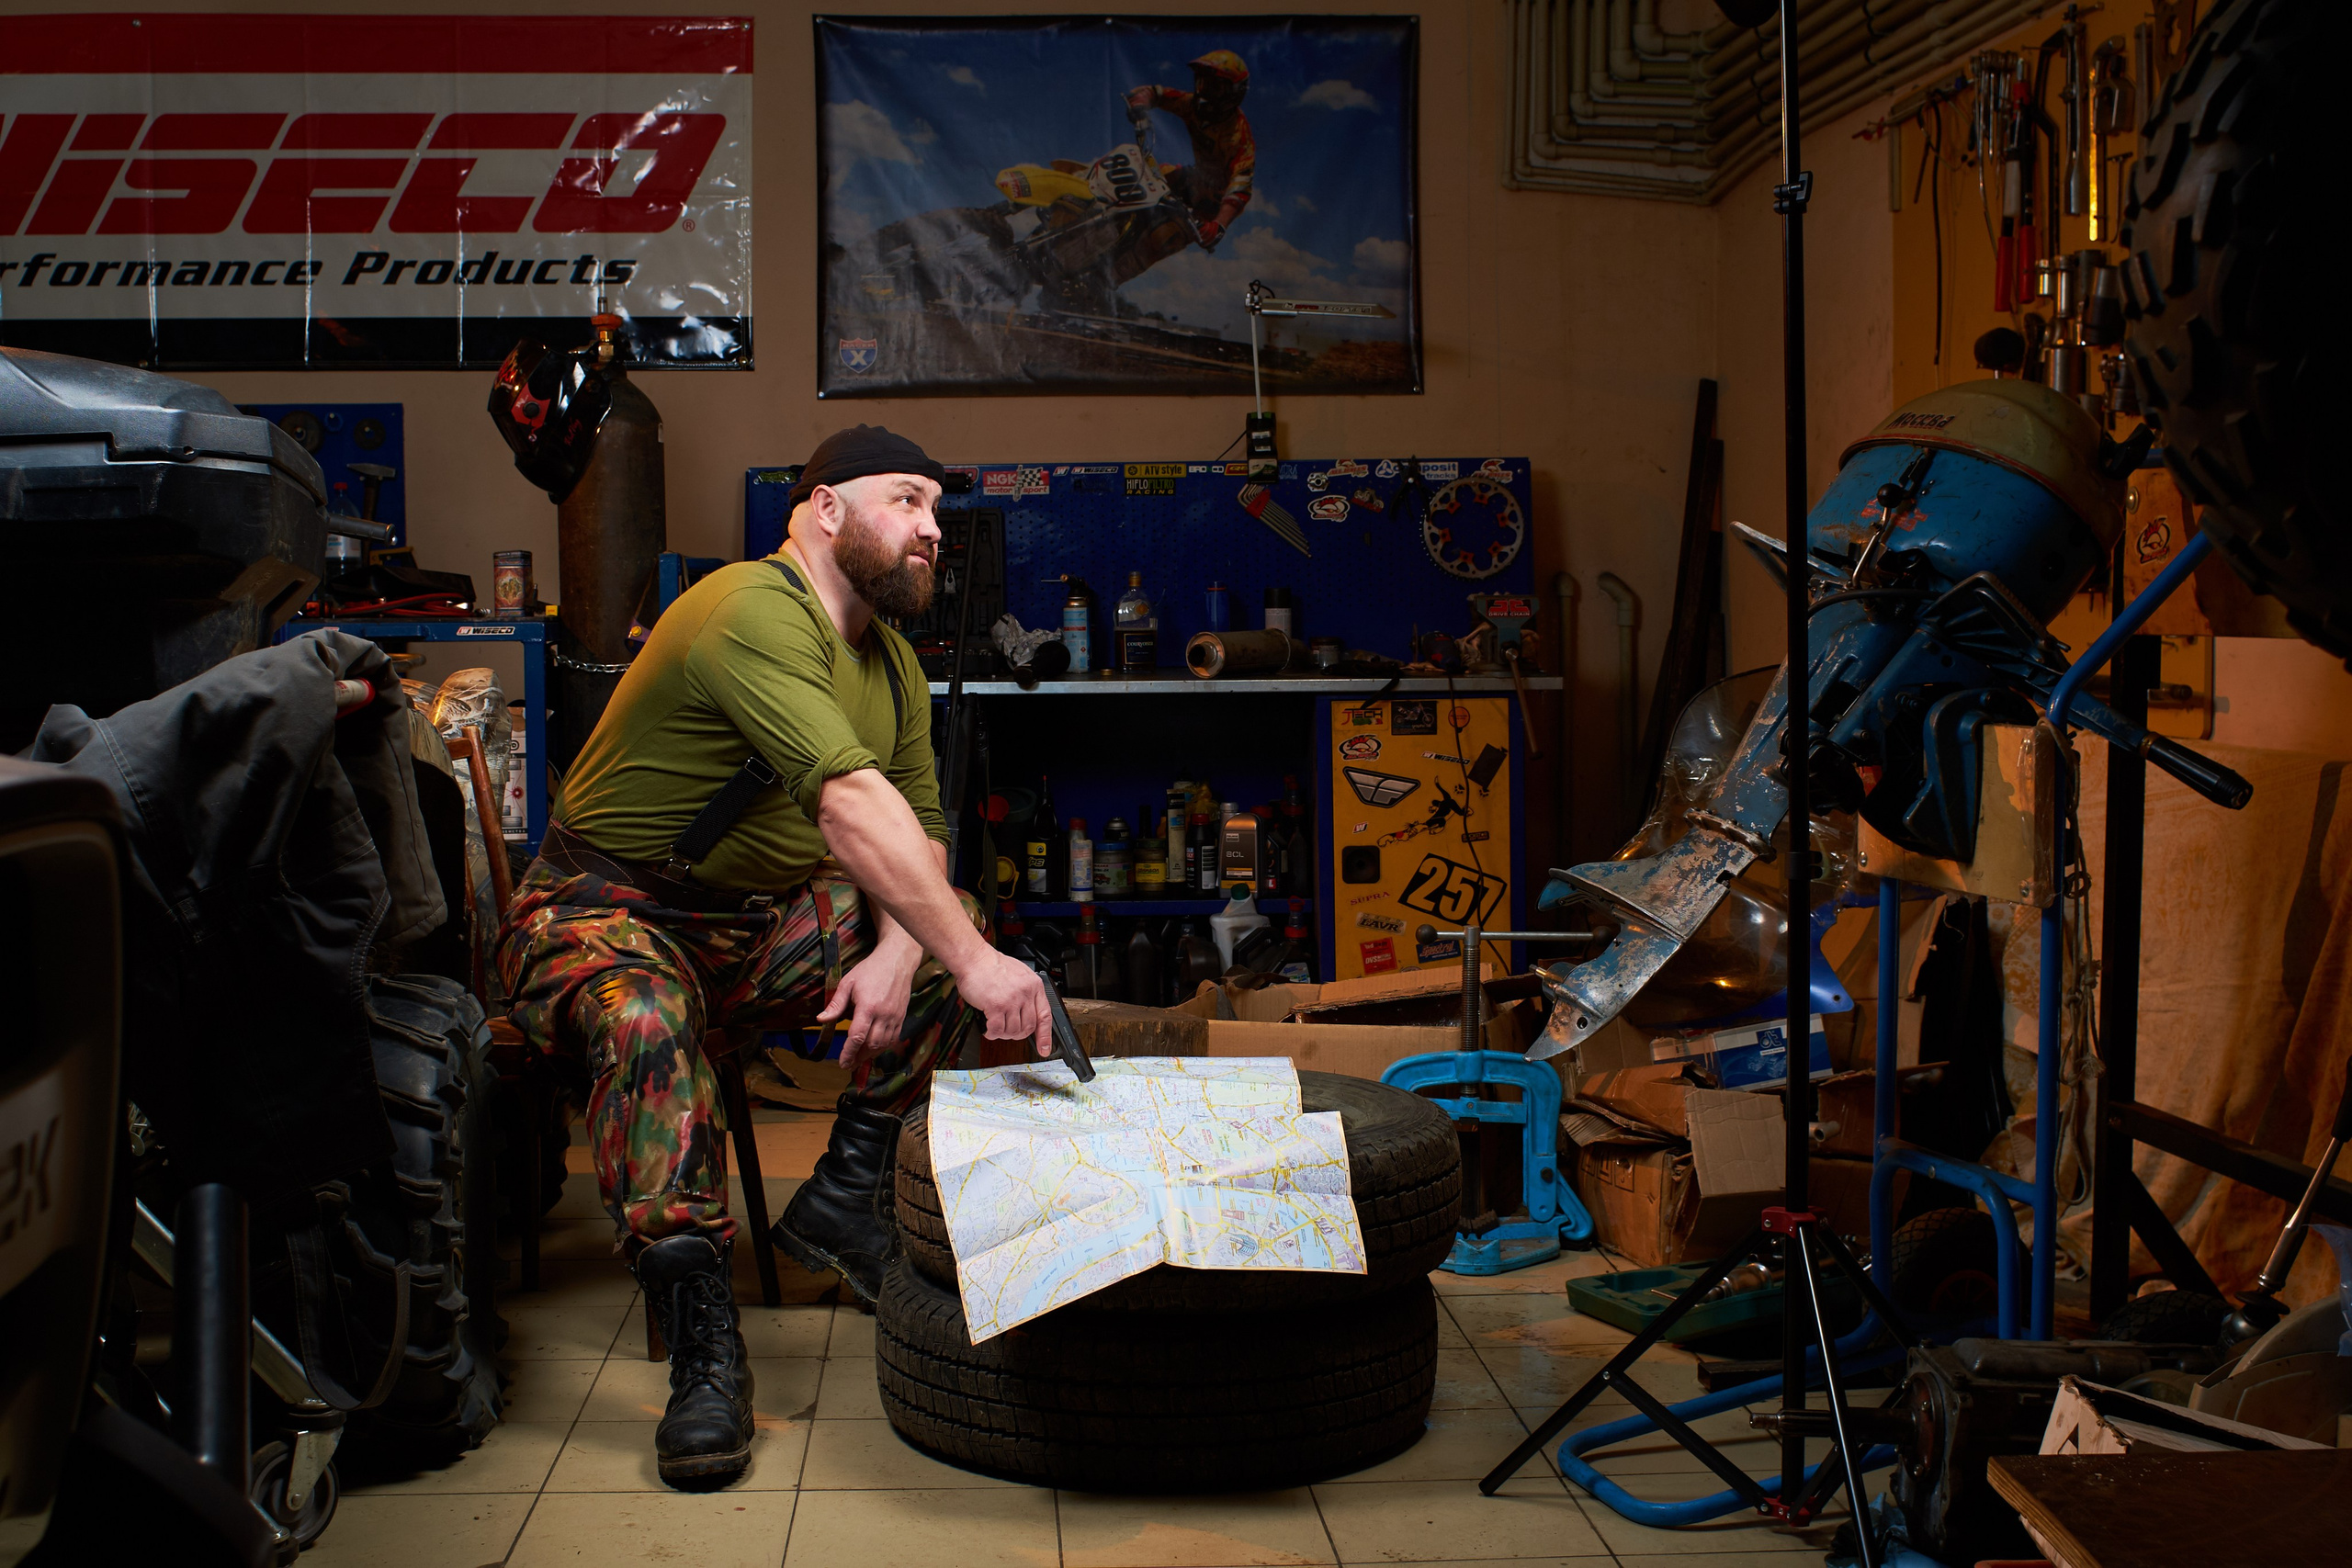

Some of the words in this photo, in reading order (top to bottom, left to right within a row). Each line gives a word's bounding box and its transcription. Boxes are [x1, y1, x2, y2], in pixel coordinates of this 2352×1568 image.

[343, 251, 638, 286] Products
[850, 349, 868, 367] X
[1145, 466, 1159, 475] ATV
[1161, 465, 1182, 475] style
[986, 473, 1017, 485] NGK
[1023, 487, 1047, 495] sport
[1407, 856, 1505, 925] 257
[1351, 891, 1391, 906] SUPRA
[1360, 918, 1400, 933] LAVR
